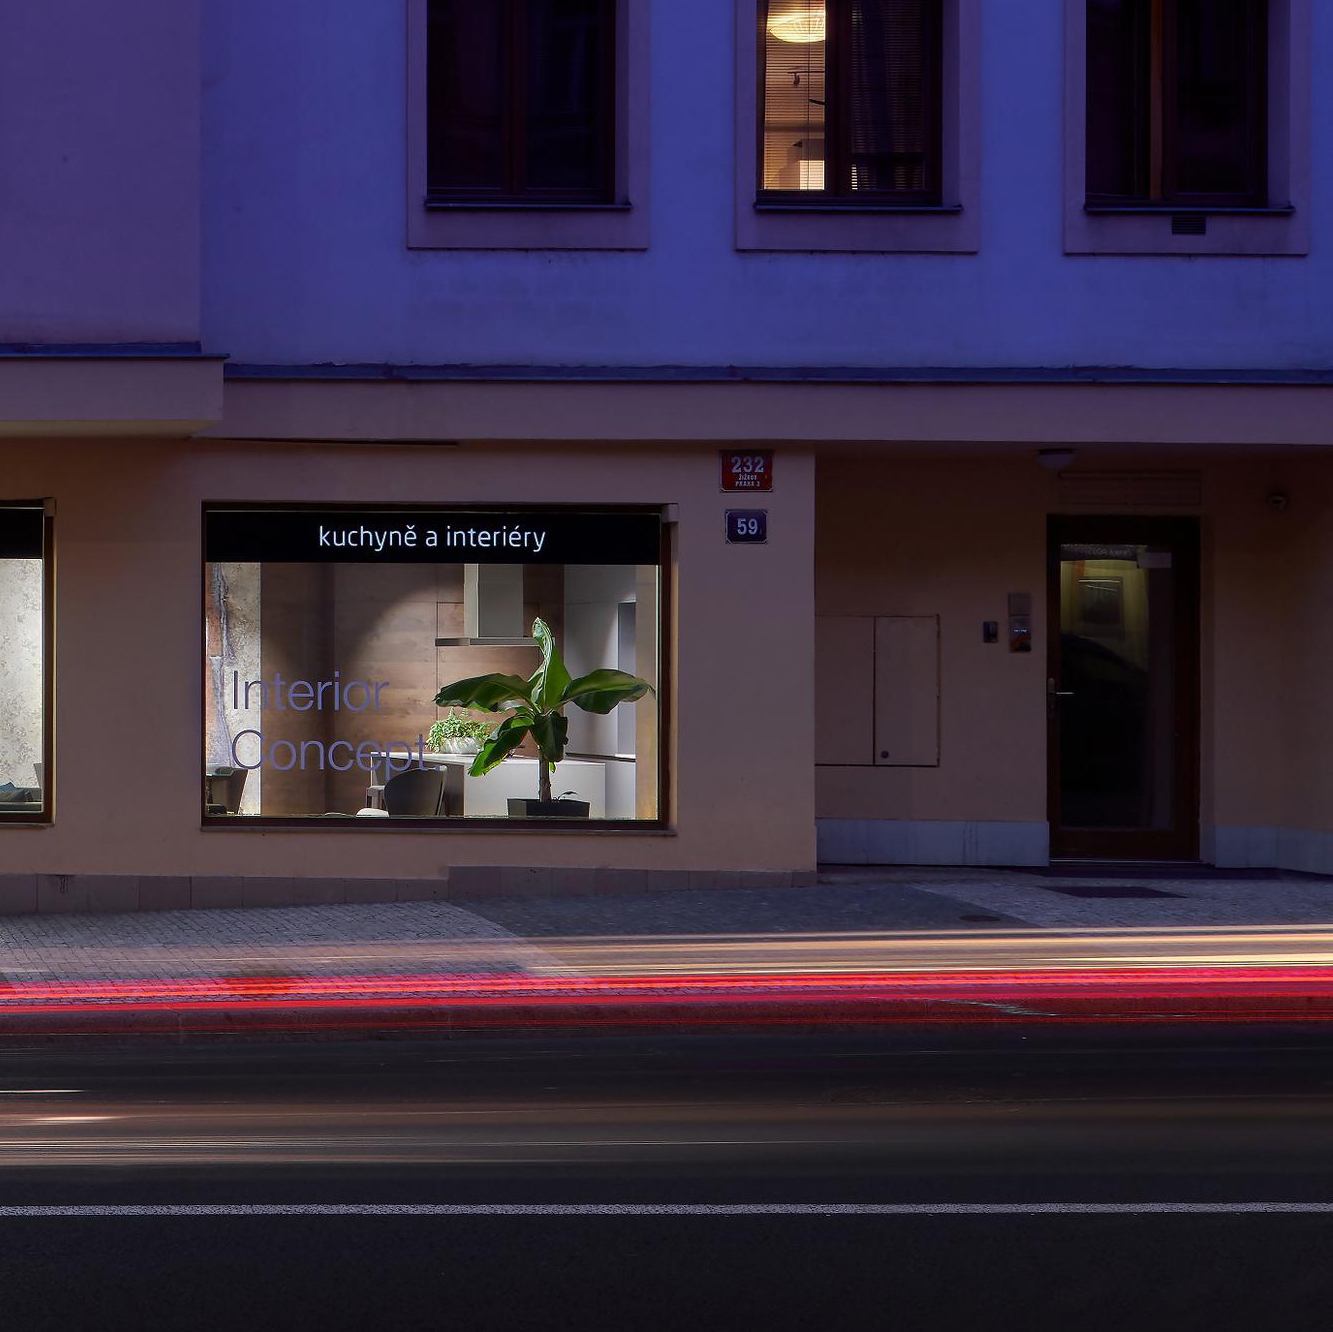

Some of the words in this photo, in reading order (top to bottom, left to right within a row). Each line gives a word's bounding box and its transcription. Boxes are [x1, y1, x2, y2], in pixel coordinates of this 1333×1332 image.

[731, 456, 764, 473] 232
[737, 517, 758, 535] 59
[319, 524, 417, 552] kuchyně
[425, 530, 438, 547] a
[446, 524, 546, 553] interiéry
[233, 670, 390, 712] Interior
